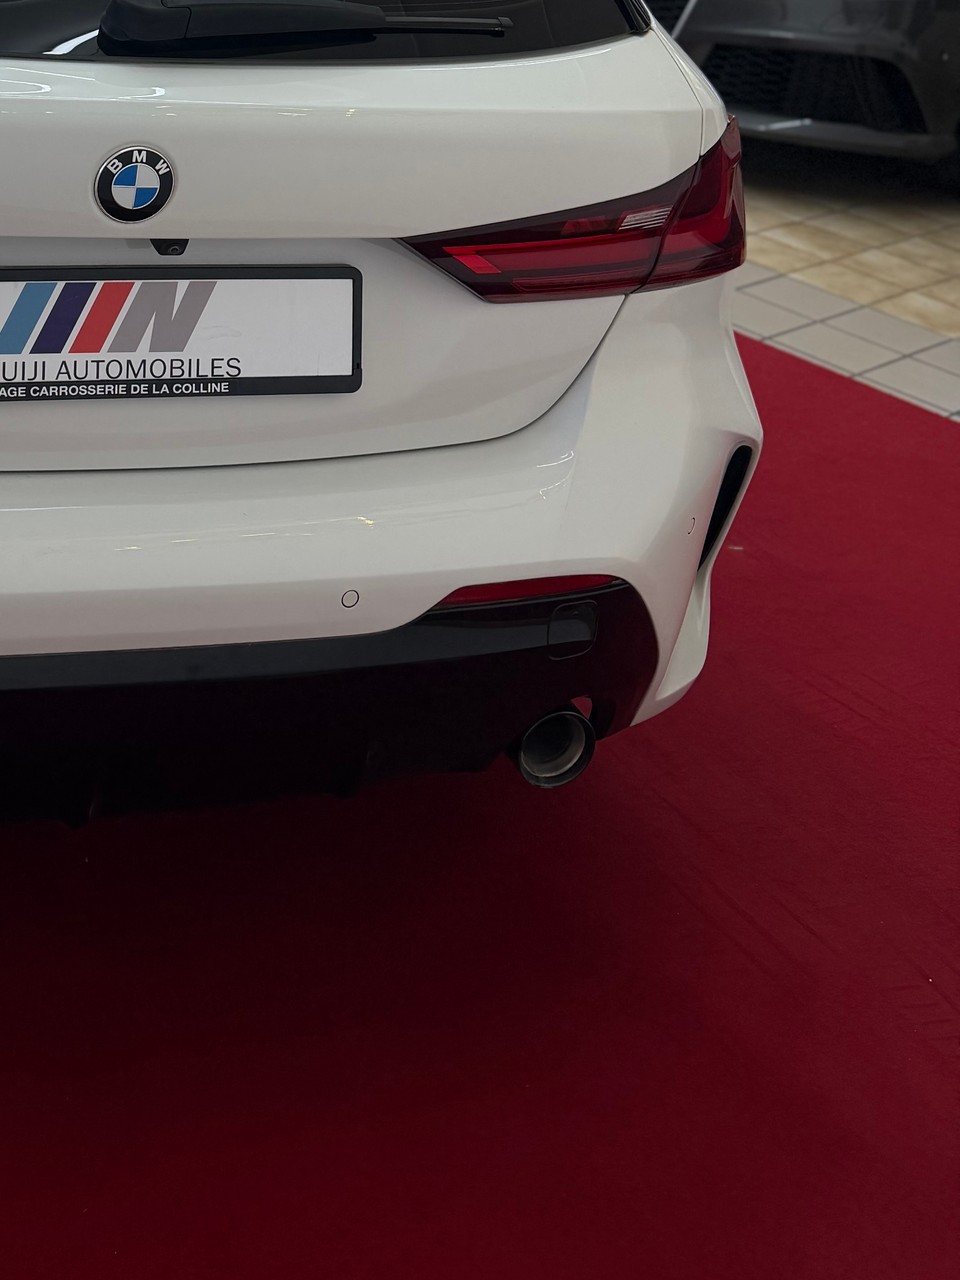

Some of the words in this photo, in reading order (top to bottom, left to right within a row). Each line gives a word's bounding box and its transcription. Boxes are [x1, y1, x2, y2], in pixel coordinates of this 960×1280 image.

[106, 150, 170, 175] BMW
[55, 357, 242, 380] AUTOMOBILES
[29, 384, 127, 397] CARROSSERIE
[130, 384, 149, 394] DE
[152, 383, 170, 394] LA
[172, 382, 230, 393] COLLINE
